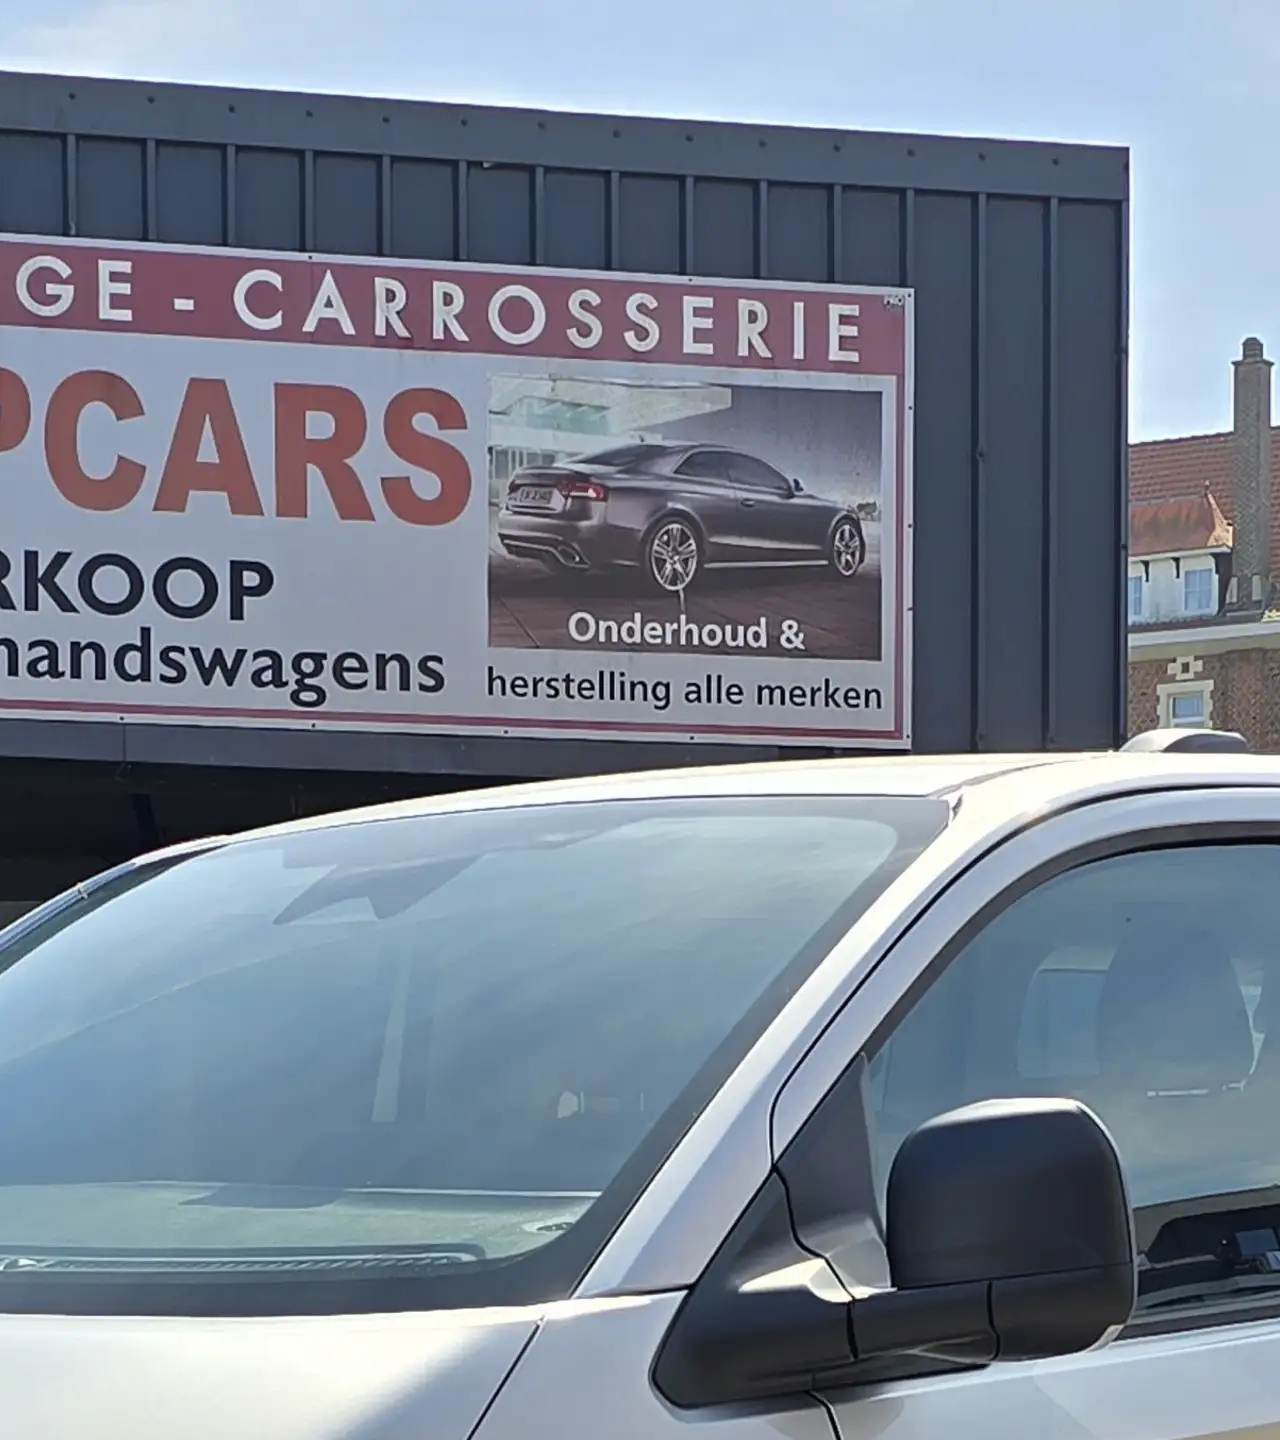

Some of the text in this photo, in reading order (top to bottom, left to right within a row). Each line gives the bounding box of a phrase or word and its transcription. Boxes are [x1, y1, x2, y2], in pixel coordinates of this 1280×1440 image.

[232, 268, 861, 364] CARROSSERIE
[567, 610, 806, 651] Onderhoud &
[486, 664, 883, 712] herstelling alle merken
